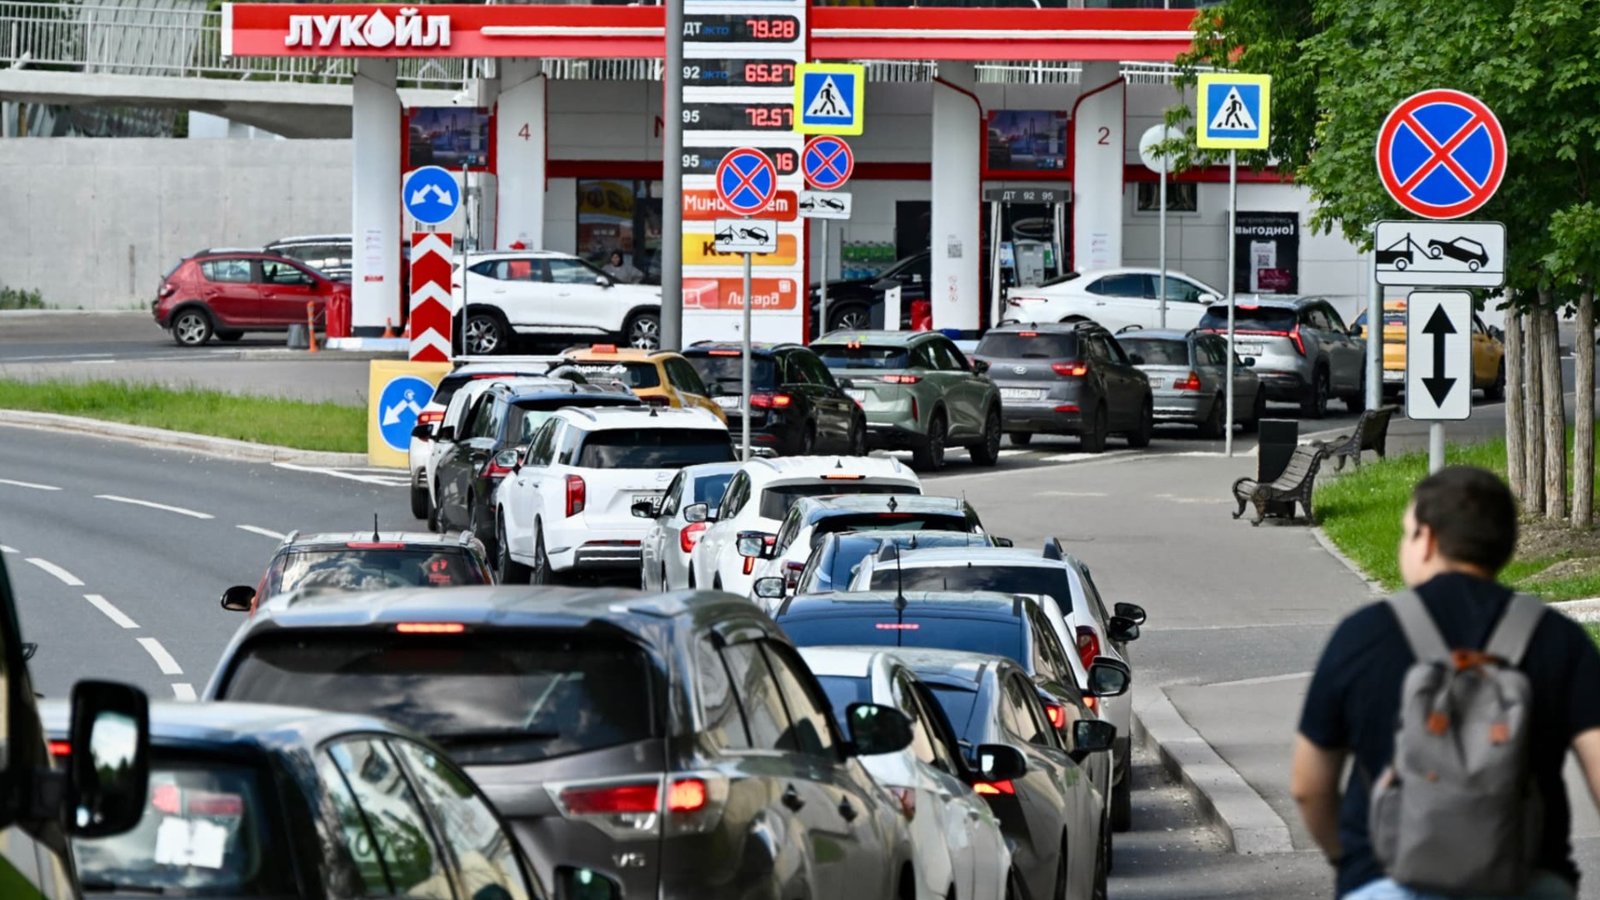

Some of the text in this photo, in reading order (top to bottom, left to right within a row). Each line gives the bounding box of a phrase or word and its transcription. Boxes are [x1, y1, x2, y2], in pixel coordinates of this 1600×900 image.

[285, 8, 451, 47] ЛУКОЙЛ
[683, 22, 702, 36] ДТ
[746, 20, 795, 38] 79.28
[683, 65, 700, 79] 92
[745, 64, 794, 82] 65.27
[682, 108, 793, 126] 95 72.57
[518, 123, 531, 141] 4
[1097, 127, 1110, 145] 2
[682, 155, 699, 167] 95
[684, 195, 788, 211] Миниет
[1002, 191, 1053, 201] ДТ 92 95
[1235, 225, 1294, 236] выгодно!
[728, 291, 780, 307] Лиард
